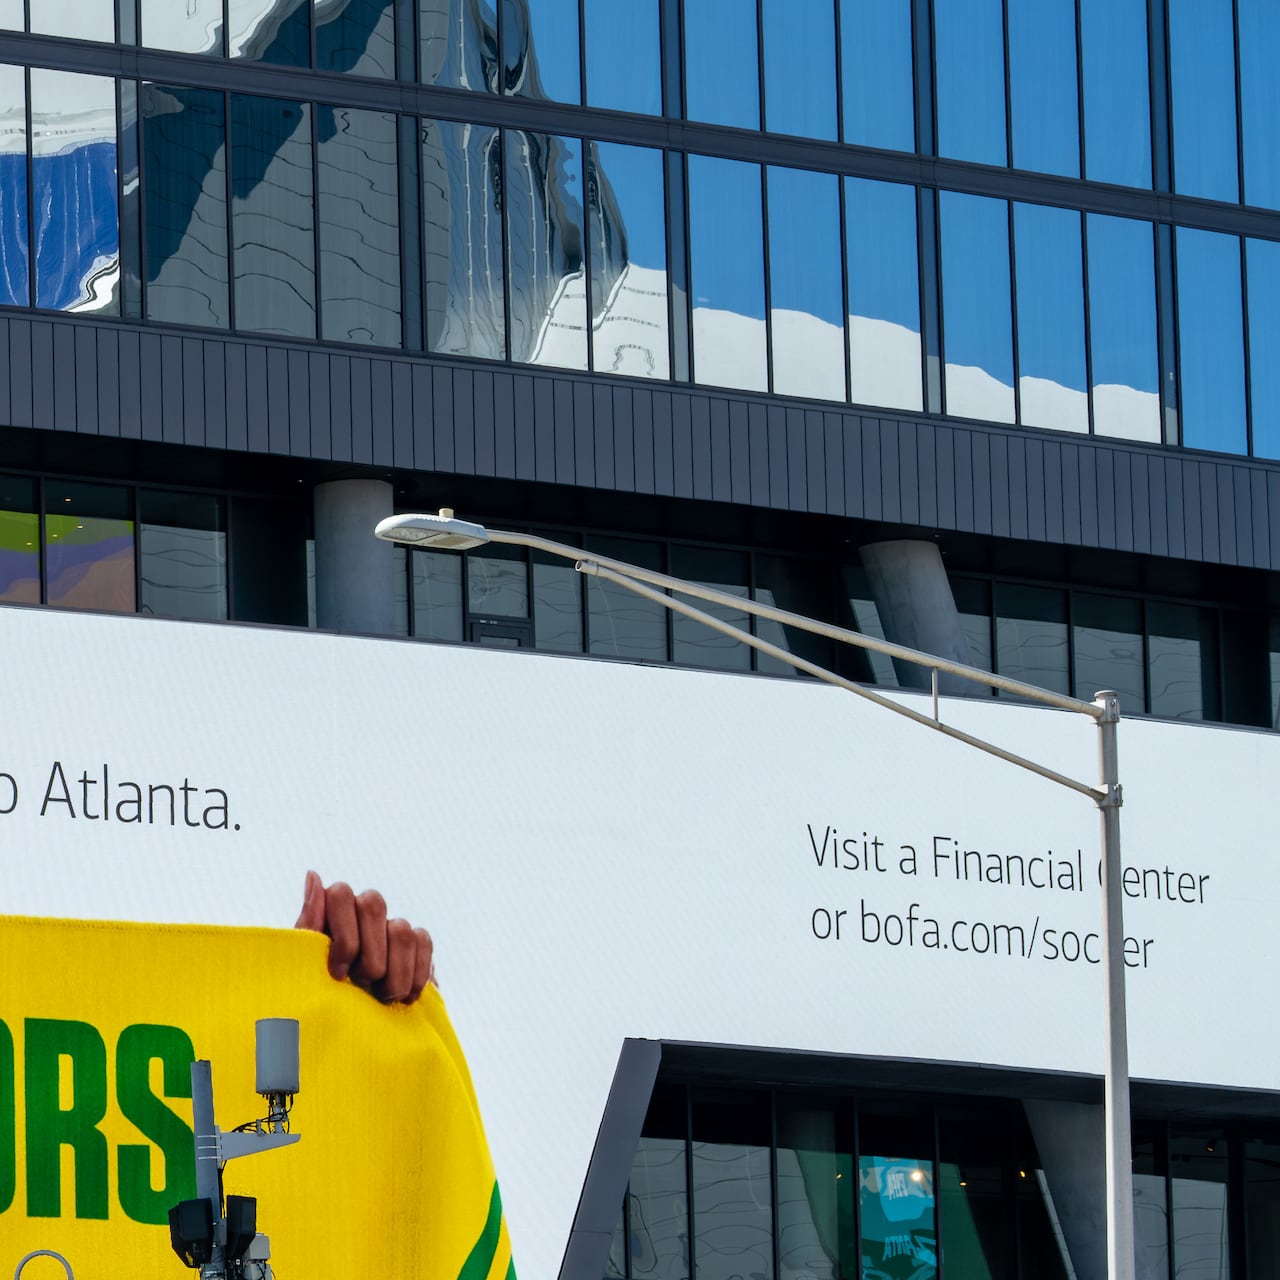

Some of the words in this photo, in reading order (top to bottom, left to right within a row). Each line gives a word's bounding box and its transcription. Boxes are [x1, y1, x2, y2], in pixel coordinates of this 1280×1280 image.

[40, 759, 243, 832] Atlanta.
[807, 824, 887, 873] Visit
[899, 844, 919, 876] a
[933, 836, 1084, 892] Financial
[1098, 859, 1210, 904] enter
[812, 906, 848, 941] or
[861, 898, 1155, 969] bofa.com/socer
